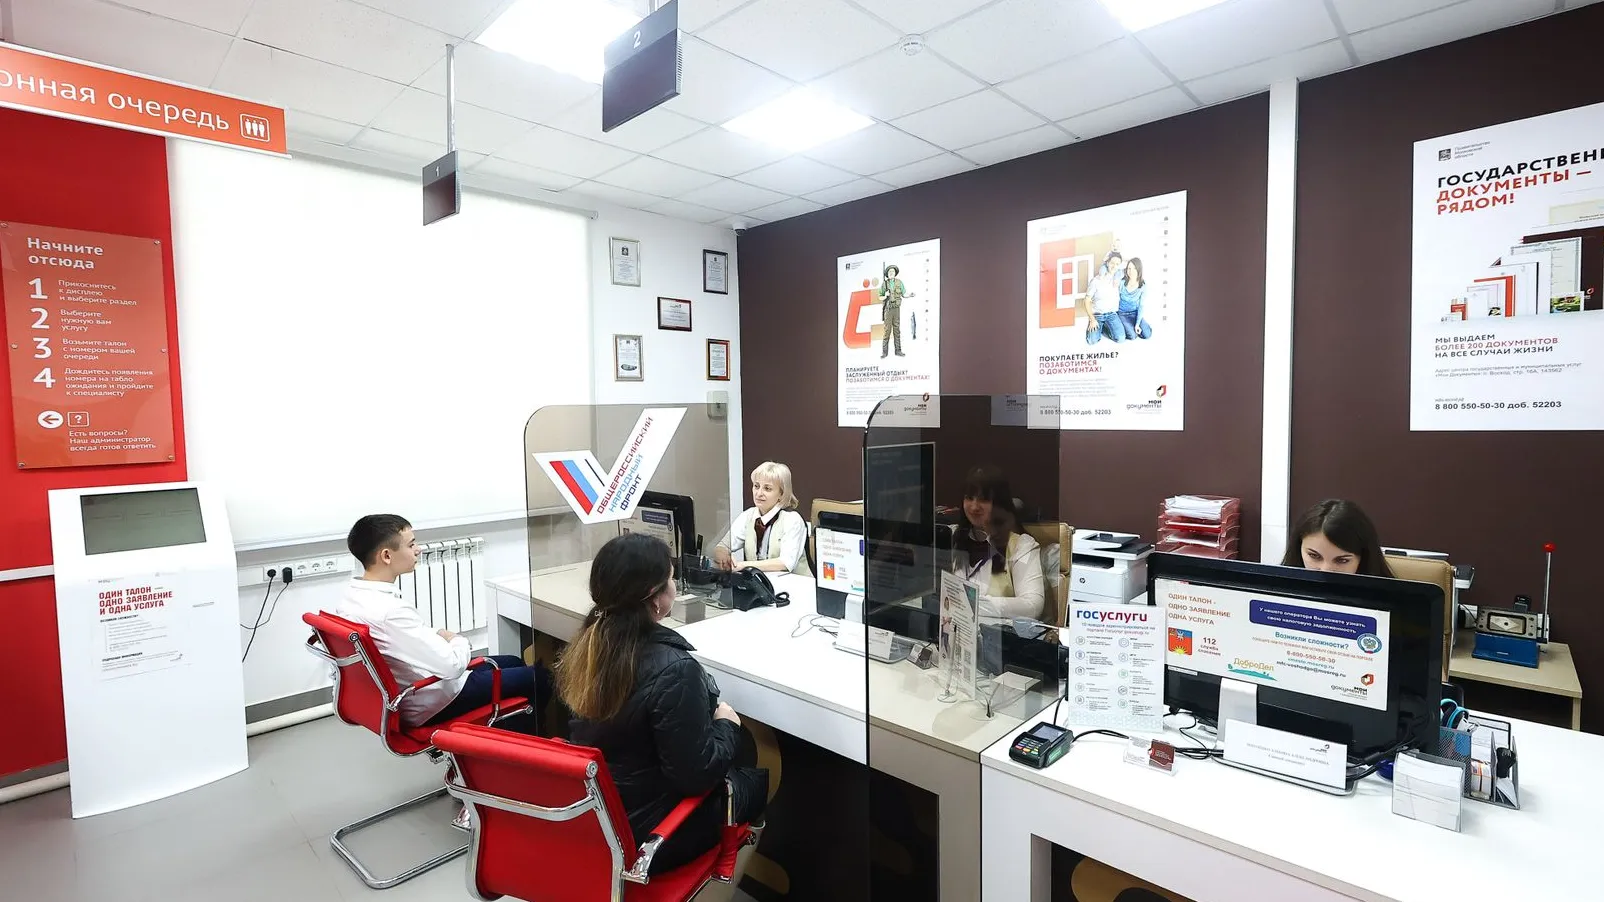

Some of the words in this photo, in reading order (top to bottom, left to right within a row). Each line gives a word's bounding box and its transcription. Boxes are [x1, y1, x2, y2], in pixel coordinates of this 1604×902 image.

[633, 30, 641, 49] 2
[107, 91, 230, 131] очередь
[435, 166, 440, 177] 1
[1436, 169, 1569, 203] ДОКУМЕНТЫ
[1437, 193, 1515, 215] РЯДОМ!
[27, 237, 104, 256] Начните
[28, 254, 94, 270] отсюда
[28, 277, 48, 299] 1
[58, 279, 116, 290] Прикоснитесь
[66, 288, 103, 296] дисплею
[67, 296, 107, 304] выберите
[30, 307, 50, 330] 2
[60, 309, 102, 318] Выберите
[61, 317, 94, 325] нужную
[61, 324, 88, 332] услугу
[62, 338, 102, 346] Возьмите
[1435, 343, 1465, 351] БОЛЕЕ
[1485, 337, 1559, 349] ДОКУМЕНТОВ
[1453, 334, 1495, 343] ВЫДАЕМ
[33, 337, 52, 359] 3
[70, 347, 108, 355] номером
[1450, 350, 1467, 358] ВСЕ
[1513, 346, 1553, 354] ЖИЗНИ
[63, 353, 99, 361] очереди
[1039, 354, 1084, 362] ПОКУПАЕТЕ
[1086, 351, 1119, 359] ЖИЛЬЕ?
[1039, 360, 1097, 369] ПОЗАБОТИМСЯ
[64, 368, 110, 376] Дождитесь
[112, 368, 153, 376] появления
[846, 370, 886, 378] ЗАСЛУЖЕННЫЙ
[1046, 367, 1102, 375] ДОКУМЕНТАХ!
[33, 367, 56, 389] 4
[116, 383, 154, 391] пройдите
[73, 390, 125, 398] специалисту
[1507, 402, 1529, 410] доб.
[89, 430, 128, 438] вопросы?
[90, 436, 151, 444] администратор
[596, 416, 654, 515] ОБЩЕРОССИЙСКИЙ
[608, 454, 644, 513] НАРОДНЫЙ
[620, 474, 642, 511] ФРОНТ
[99, 590, 122, 600] ОДИН
[125, 586, 151, 596] ТАЛОН
[1168, 593, 1187, 601] ОДИН
[1189, 595, 1212, 605] ТАЛОН
[99, 597, 123, 608] ОДНО
[126, 591, 173, 604] ЗАЯВЛЕНИЕ
[109, 605, 132, 614] ОДНА
[134, 600, 164, 610] УСЛУГА
[1168, 603, 1188, 611] ОДНО
[1189, 606, 1231, 618] ЗАЯВЛЕНИЕ
[1076, 610, 1147, 623] госуслуги
[1168, 612, 1187, 621] ОДНА
[1189, 615, 1215, 625] УСЛУГА
[1203, 637, 1216, 645] 112
[1275, 631, 1306, 642] Возникли
[1308, 638, 1349, 649] сложности?
[1233, 658, 1274, 671] ДоброДел
